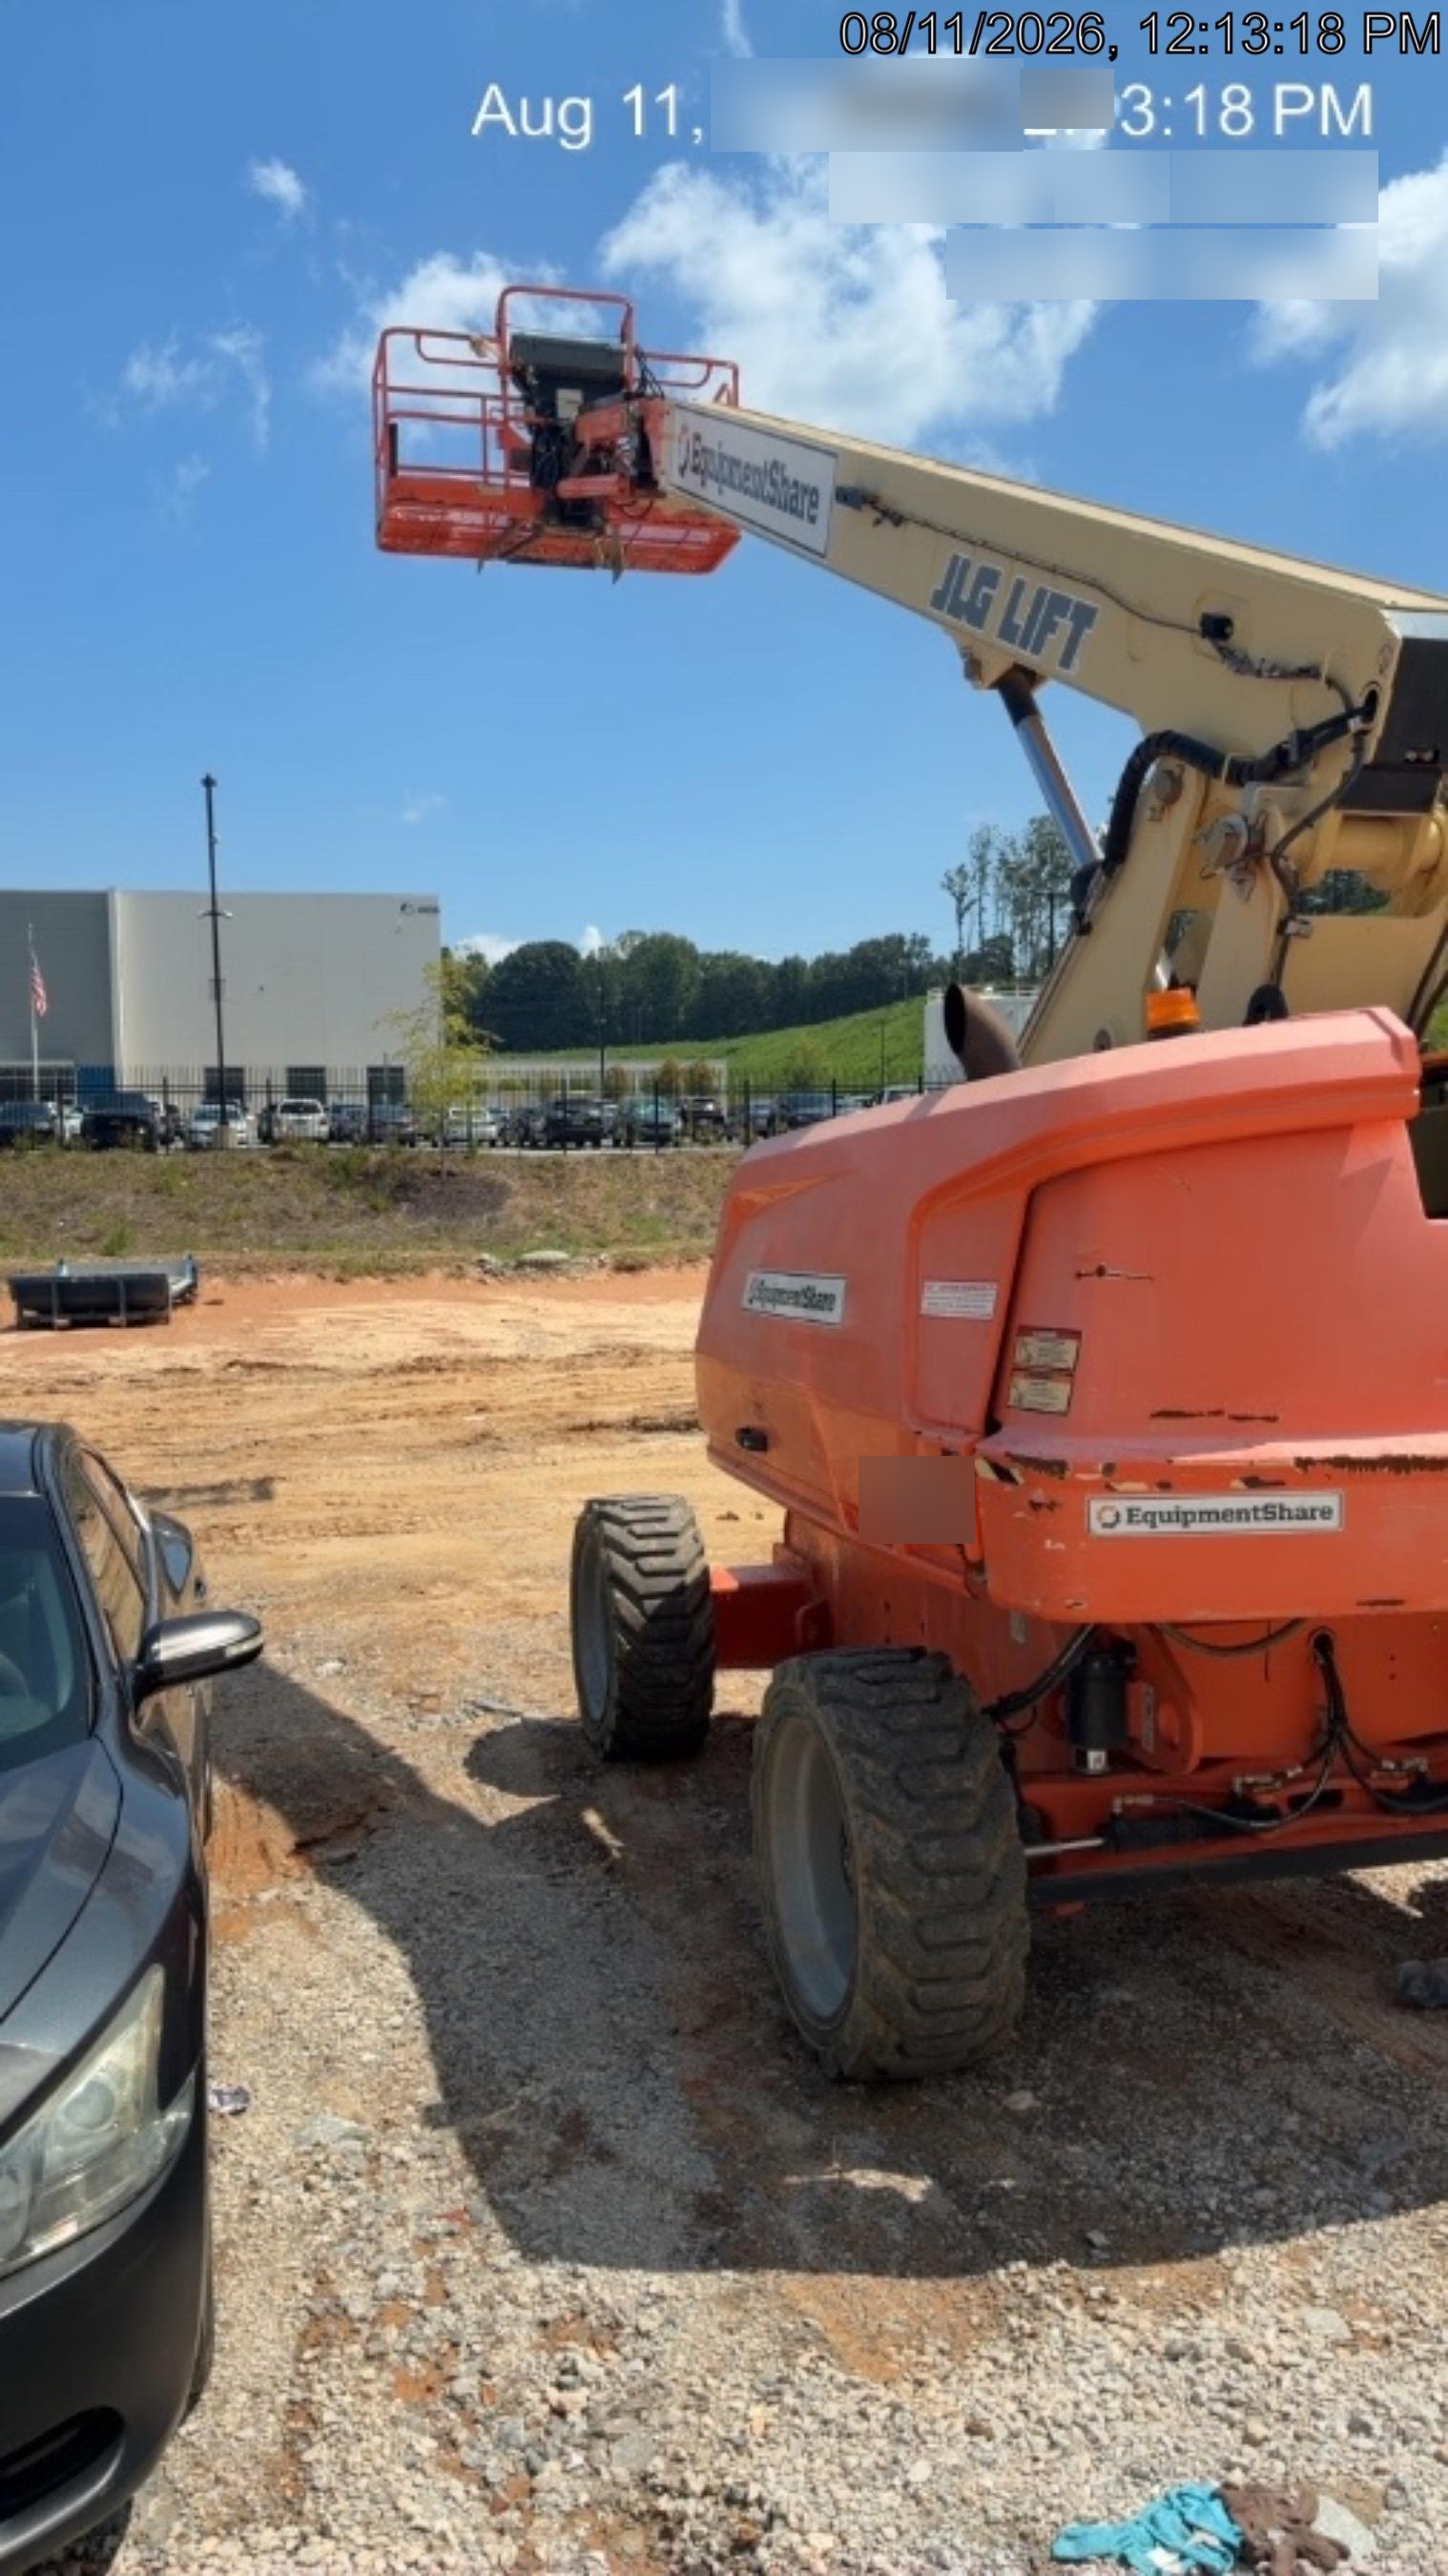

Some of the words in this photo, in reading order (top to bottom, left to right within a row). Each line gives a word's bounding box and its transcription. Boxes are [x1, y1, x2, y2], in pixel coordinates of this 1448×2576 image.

[691, 431, 819, 525] EquipmentShare
[929, 551, 1005, 634] JLG
[997, 575, 1099, 675] LIFT
[1126, 1503, 1334, 1529] EquipmentShare
